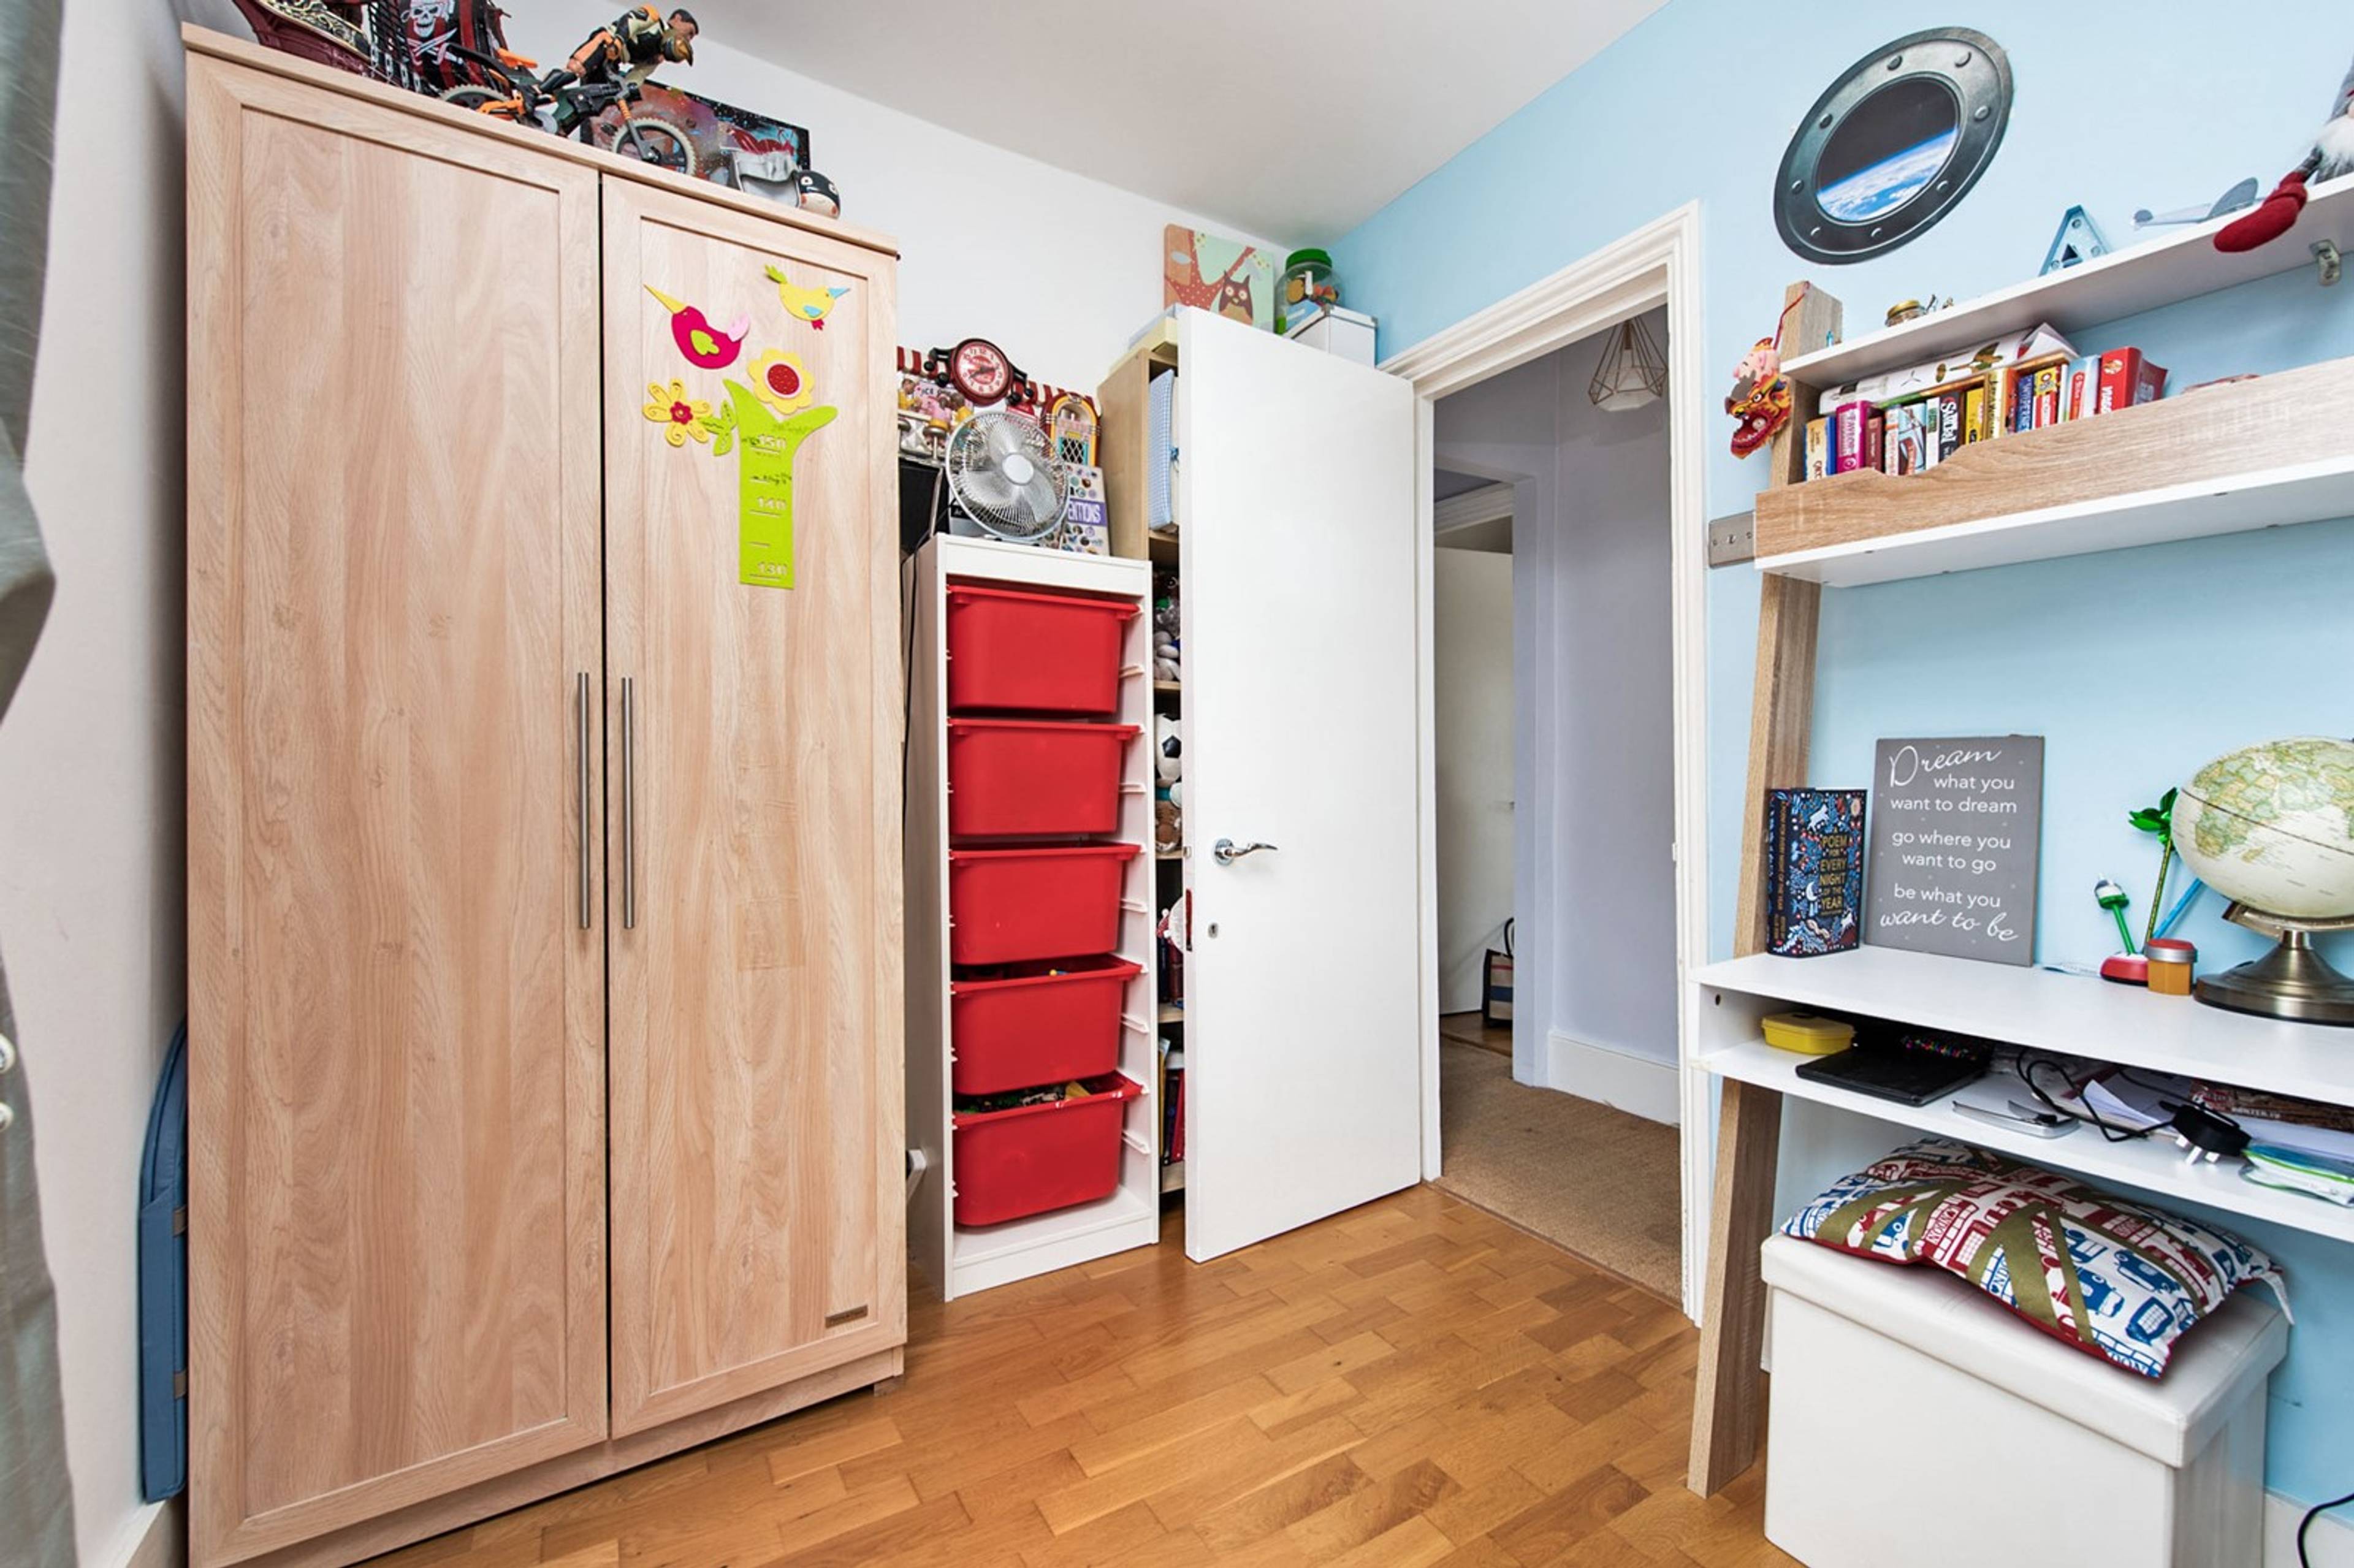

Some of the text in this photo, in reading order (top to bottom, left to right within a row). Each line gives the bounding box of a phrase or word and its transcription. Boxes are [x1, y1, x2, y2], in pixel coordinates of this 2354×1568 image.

[1889, 745, 2002, 788] Dream
[1933, 774, 2014, 793] what you
[1890, 797, 2017, 813] want to dream
[1821, 835, 1848, 848] POEM
[1892, 829, 2011, 851] go where you
[1819, 859, 1847, 872] EVERY
[1902, 853, 1997, 874] want to go
[1819, 872, 1846, 885] NIGHT
[1821, 896, 1843, 910] YEAR
[1894, 883, 2001, 909] be what you
[1880, 908, 2019, 942] want to be
